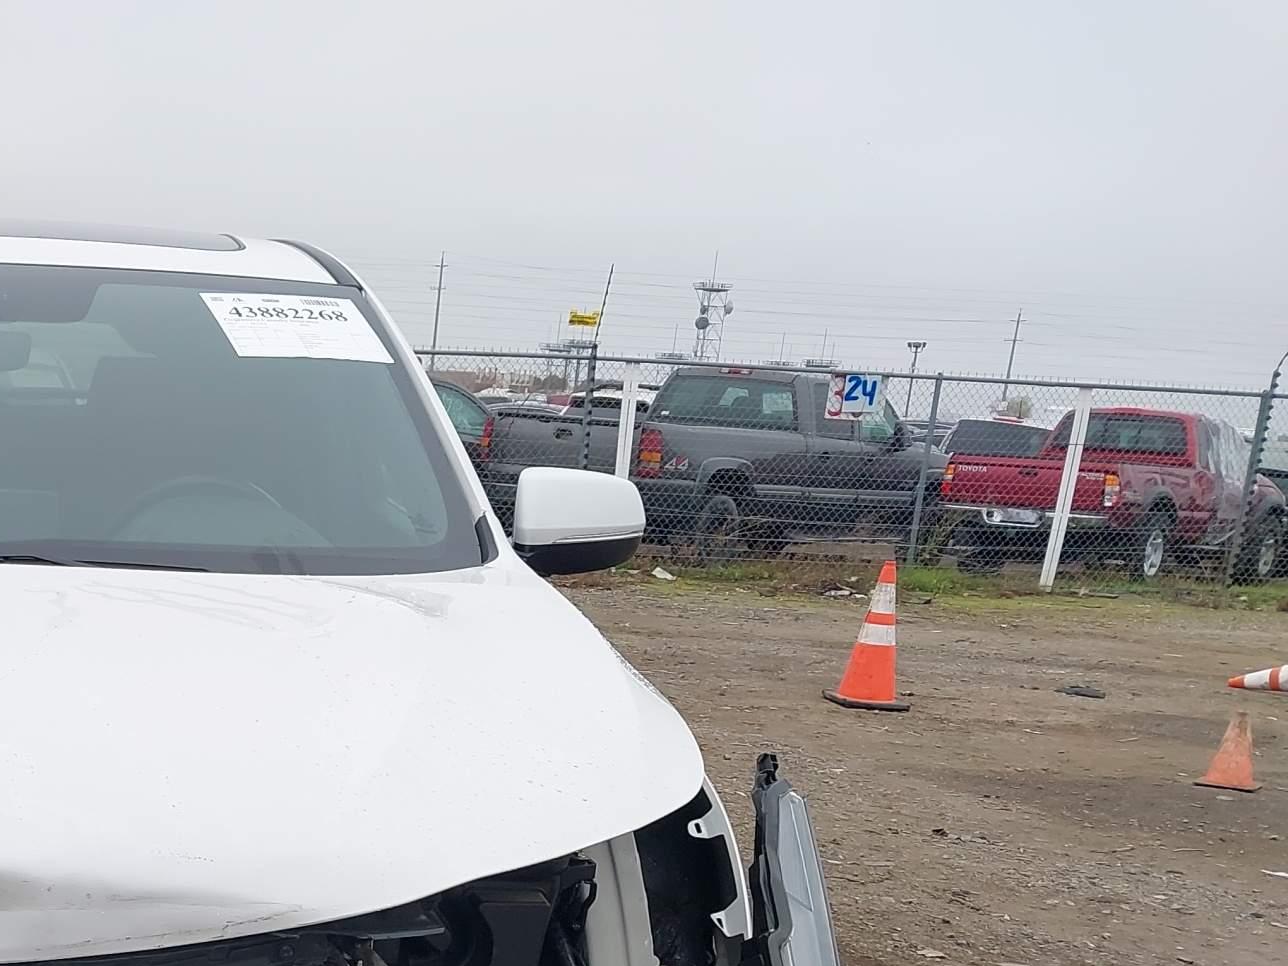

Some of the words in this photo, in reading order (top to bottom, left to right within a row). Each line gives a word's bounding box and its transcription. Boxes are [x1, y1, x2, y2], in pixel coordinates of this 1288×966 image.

[229, 305, 348, 322] 43882268
[844, 375, 877, 406] 24
[957, 464, 987, 473] TOYOTA
